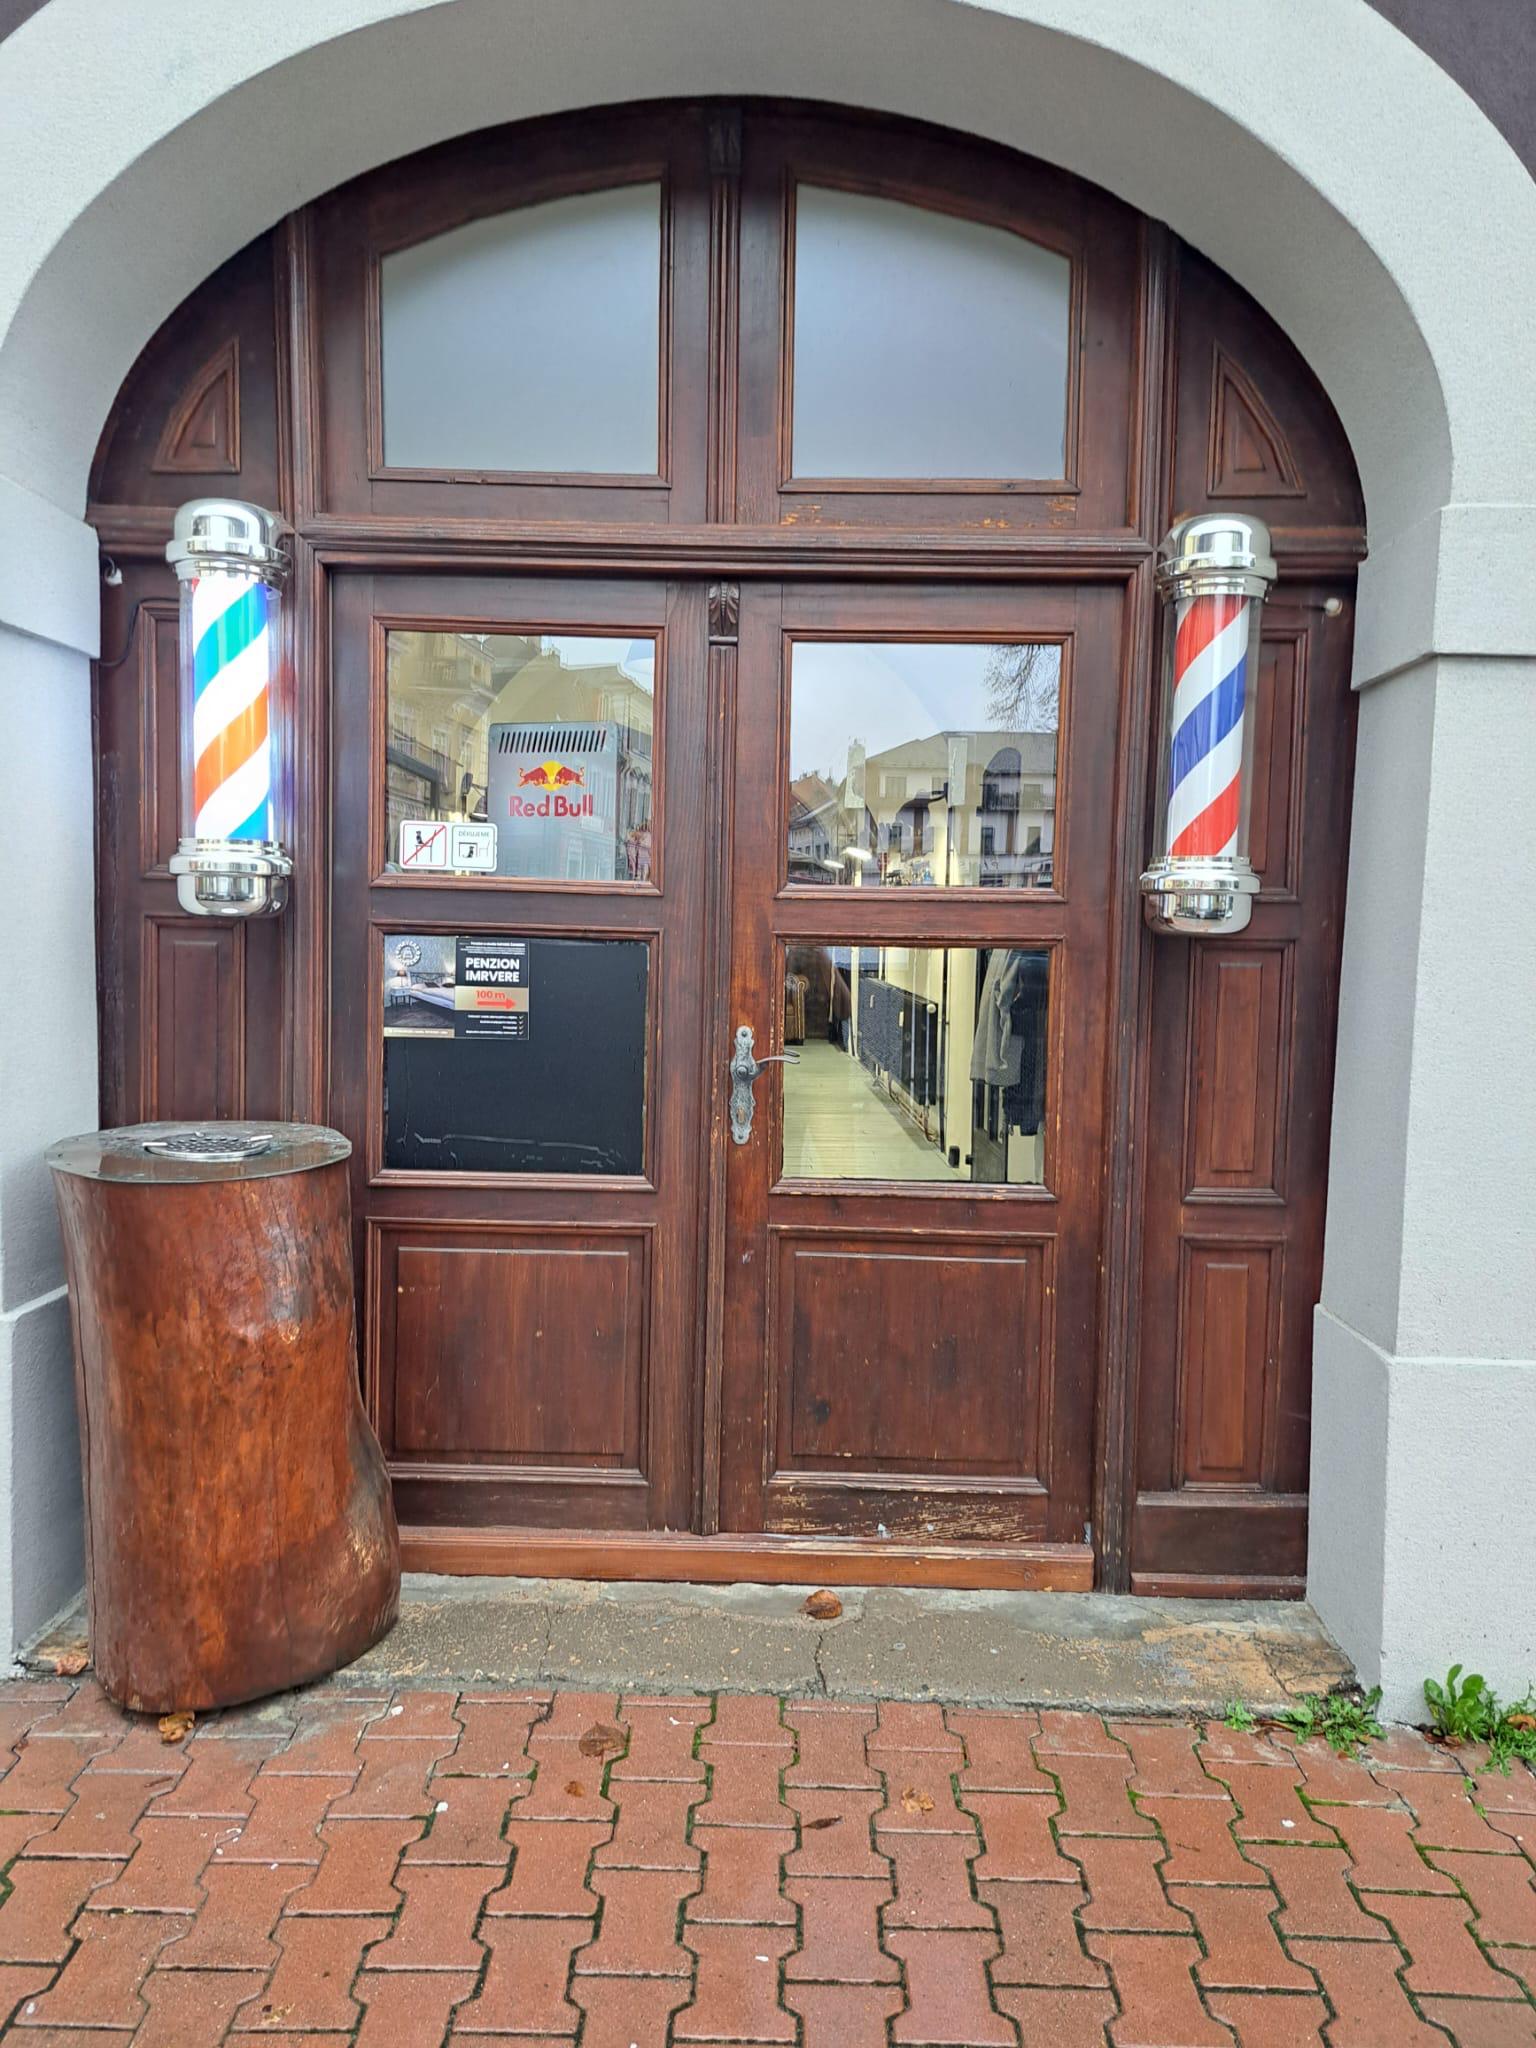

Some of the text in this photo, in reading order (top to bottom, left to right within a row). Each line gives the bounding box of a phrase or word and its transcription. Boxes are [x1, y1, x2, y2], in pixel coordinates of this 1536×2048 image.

[509, 794, 593, 816] Red Bull
[466, 957, 520, 970] PENZION
[466, 970, 520, 982] IMRVERE
[476, 990, 492, 999] 100
